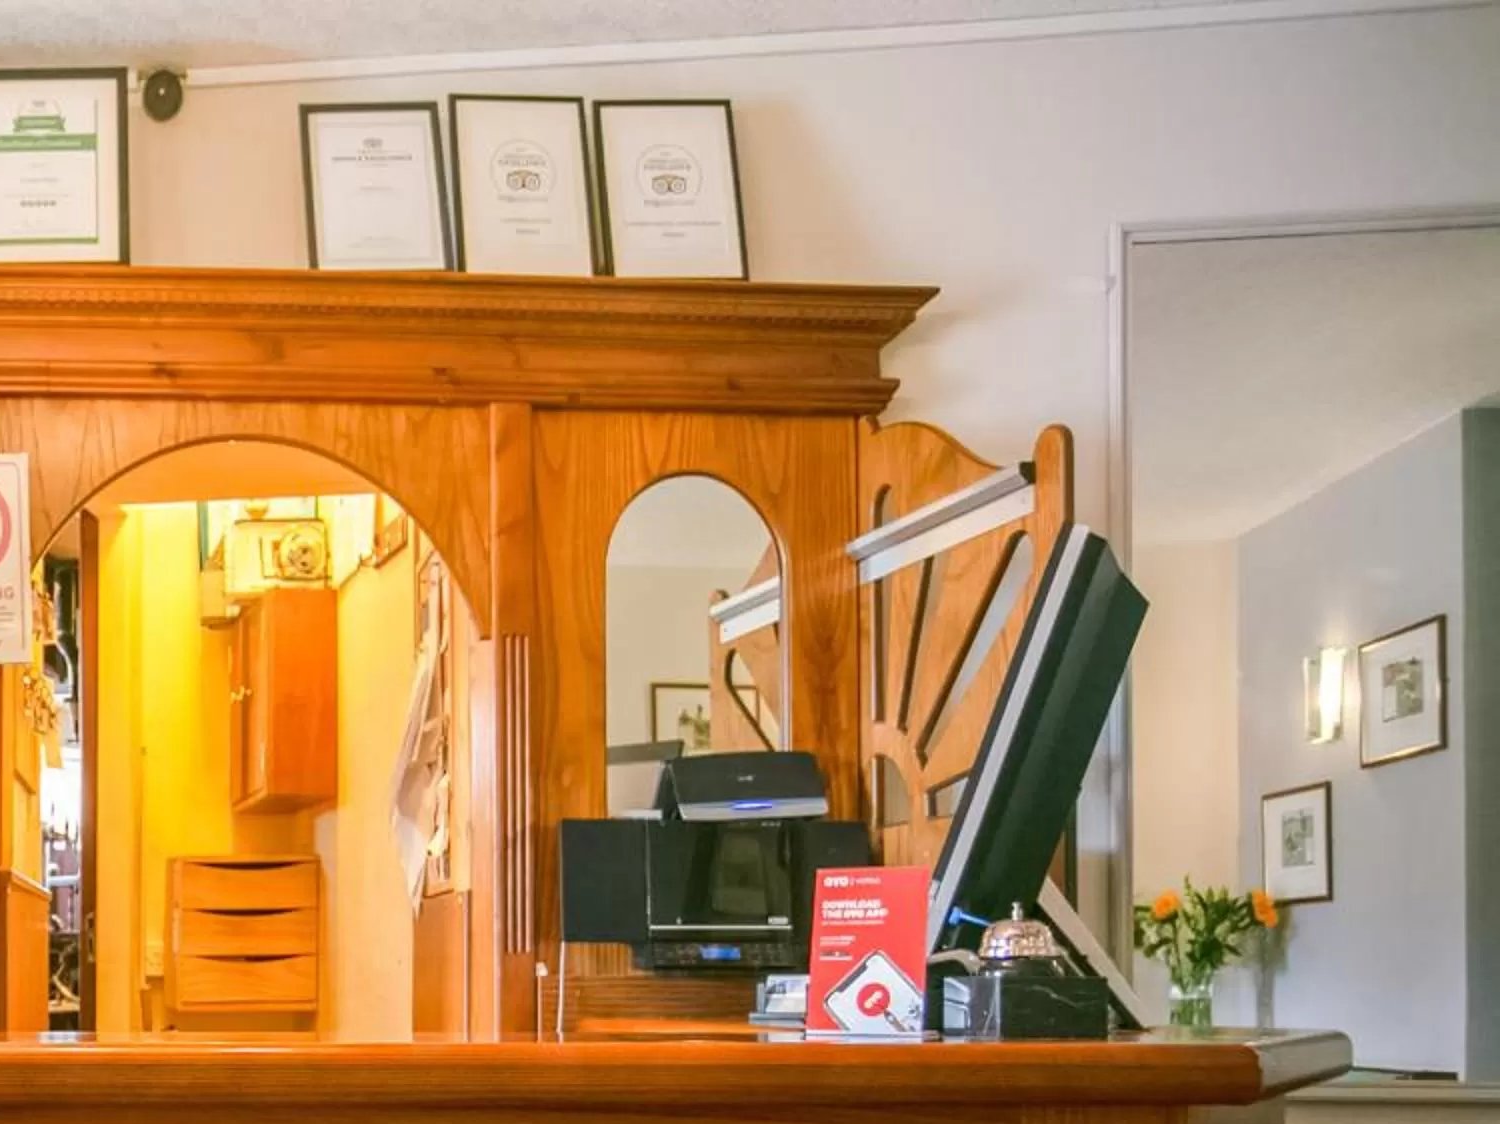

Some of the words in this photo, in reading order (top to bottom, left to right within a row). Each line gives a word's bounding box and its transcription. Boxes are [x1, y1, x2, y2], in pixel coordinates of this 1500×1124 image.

[823, 876, 849, 888] OYO
[821, 899, 882, 909] DOWNLOAD
[821, 909, 843, 919] THE
[866, 907, 889, 917] APP
